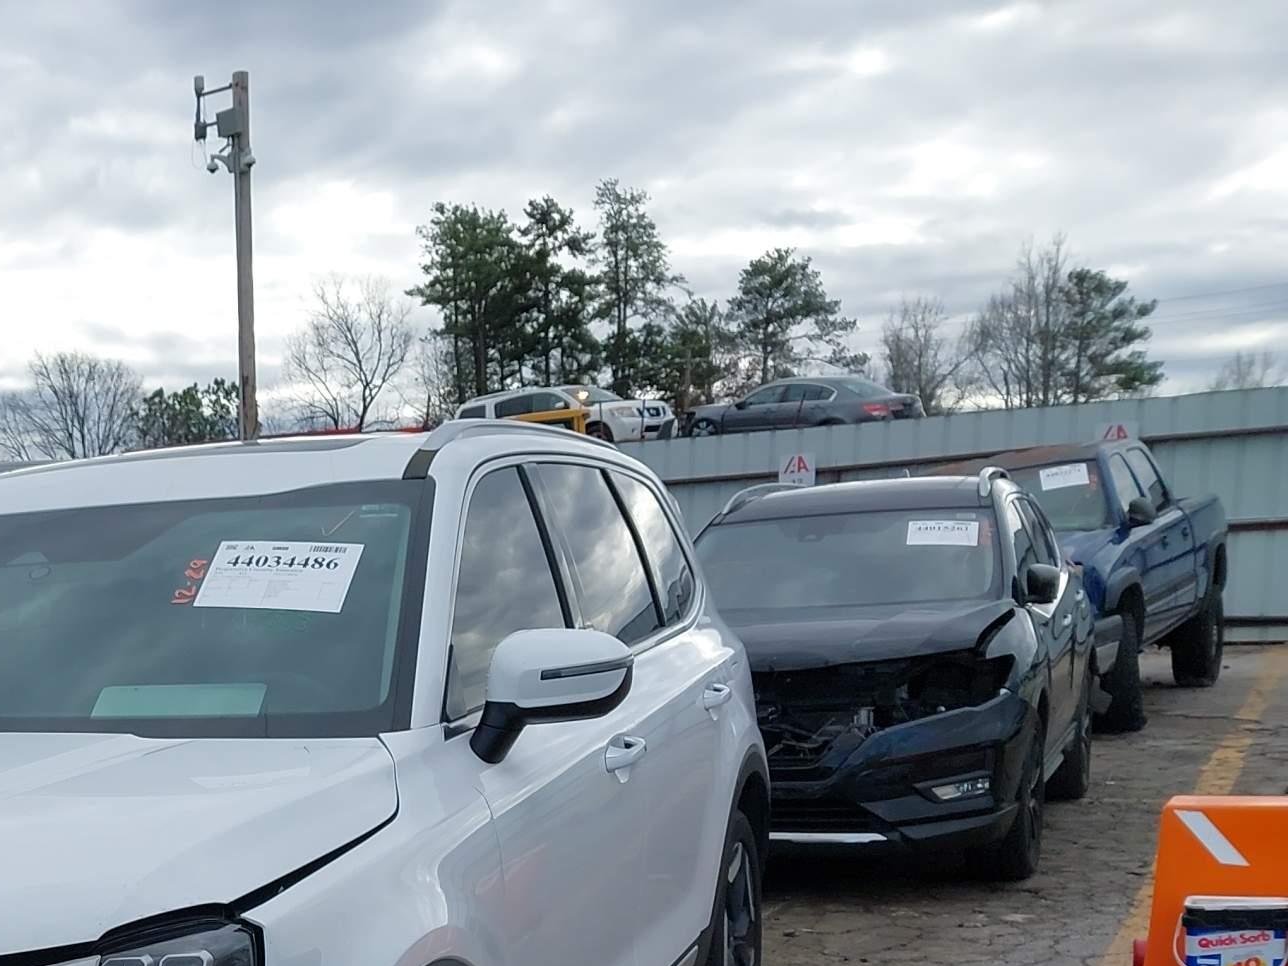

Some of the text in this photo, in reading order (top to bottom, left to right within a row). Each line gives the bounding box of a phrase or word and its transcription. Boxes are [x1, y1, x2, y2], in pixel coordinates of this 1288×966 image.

[226, 554, 340, 570] 44034486
[1198, 930, 1271, 949] Quick Sorb
